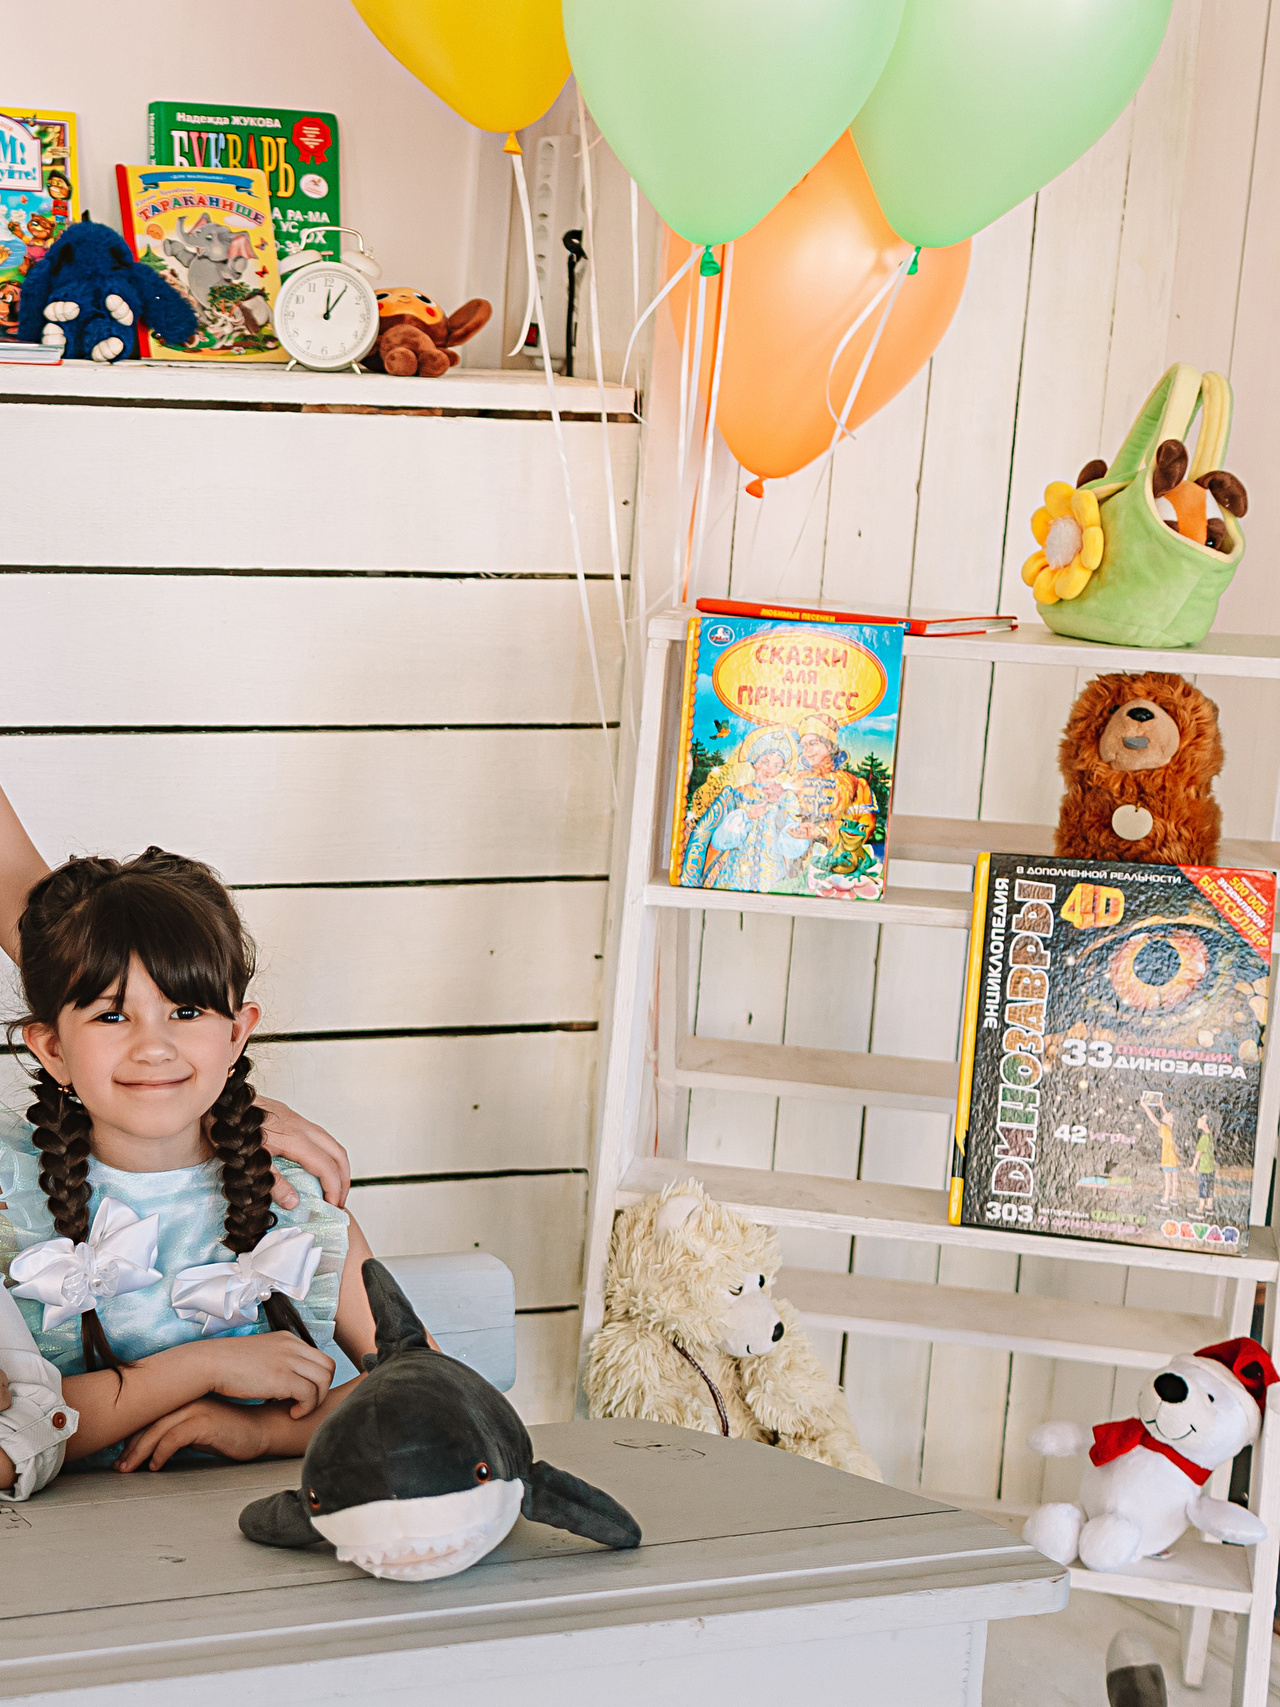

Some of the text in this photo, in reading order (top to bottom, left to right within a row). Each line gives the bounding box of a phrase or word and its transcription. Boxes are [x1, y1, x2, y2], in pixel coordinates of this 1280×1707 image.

[176, 112, 282, 129] Надежда ЖУКОВА
[286, 209, 331, 224] РА-МА
[755, 644, 849, 668] СКАЗКИ
[782, 670, 818, 685] ДЛЯ
[737, 685, 859, 713] ПРИНЦЕСС
[1016, 866, 1182, 884] В ДОПОЛНЕННОЙ РЕАЛЬНОСТИ
[1060, 883, 1125, 930] 4D
[1229, 876, 1250, 897] 500
[1247, 895, 1267, 915] 000
[1199, 875, 1270, 947] БЕСТСЕЛЛЕР
[984, 877, 1010, 1030] ЭНЦИКЛОПЕДИЯ
[1061, 1038, 1113, 1068] 33
[1113, 1055, 1247, 1080] ДИНОЗАВРА
[1054, 1124, 1088, 1144] 42
[986, 1201, 1033, 1223] 303
